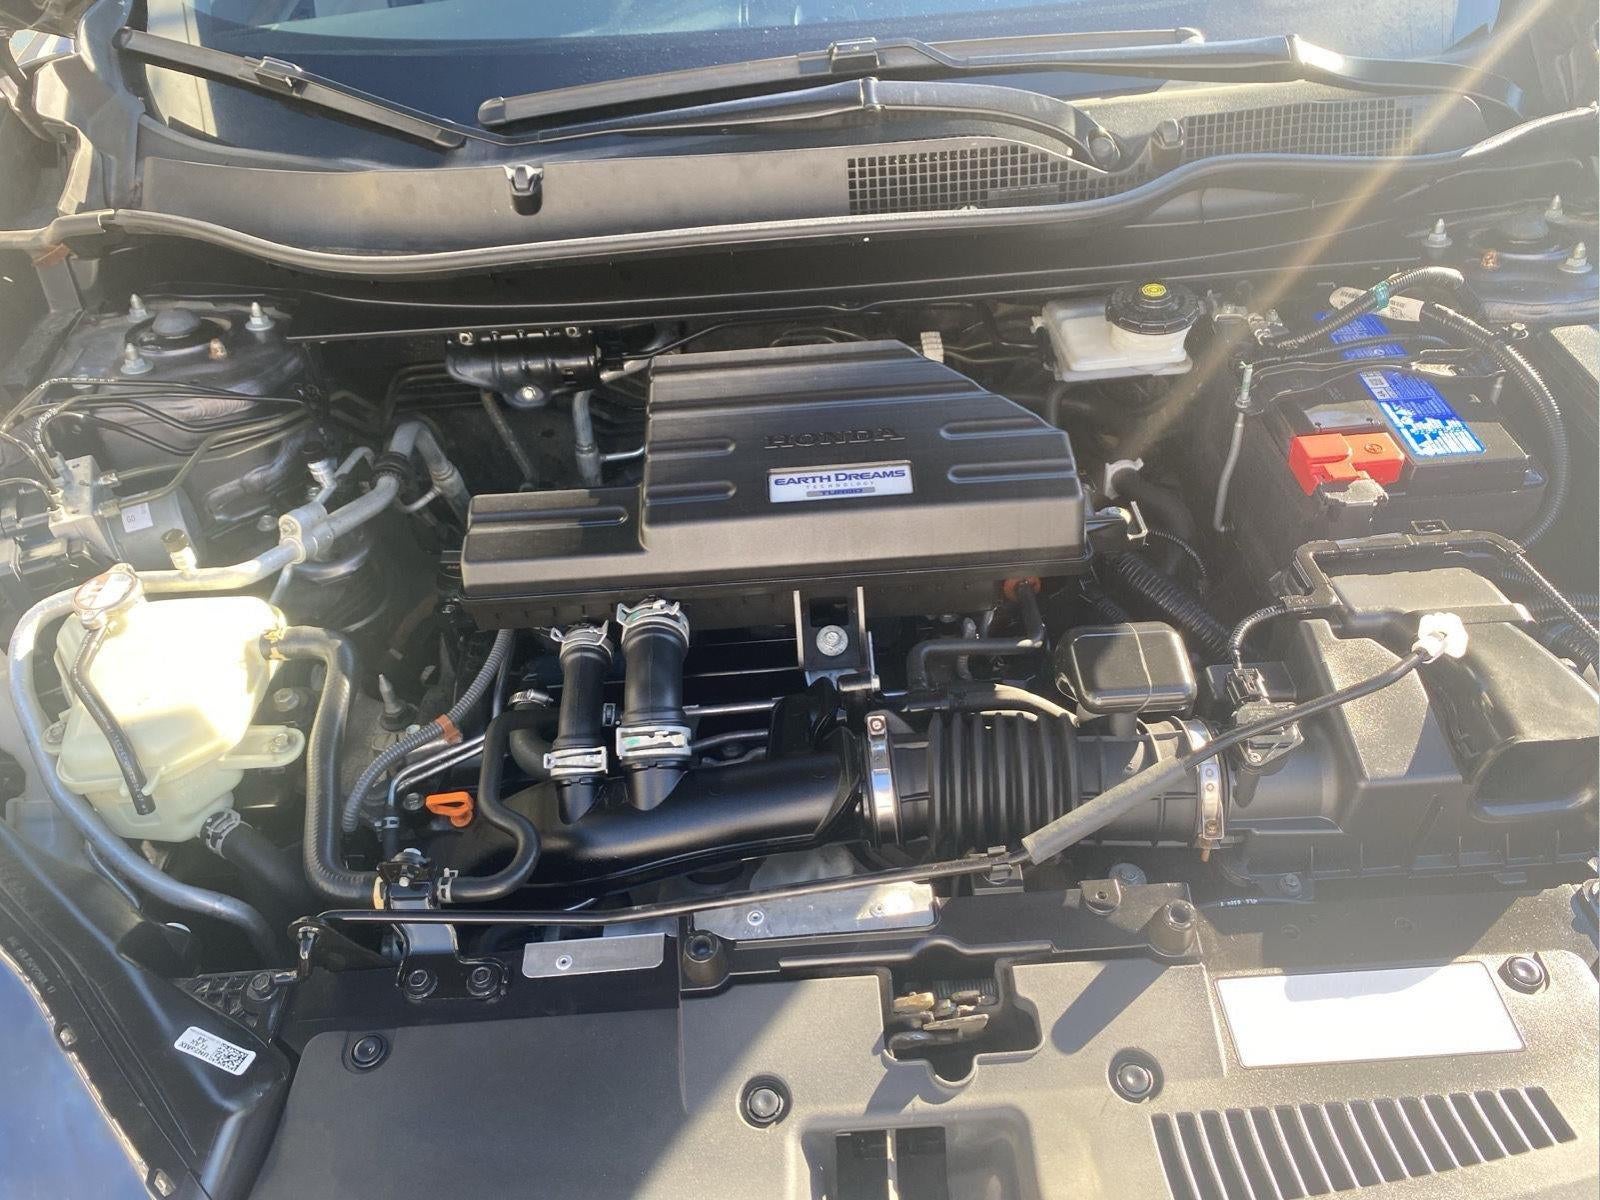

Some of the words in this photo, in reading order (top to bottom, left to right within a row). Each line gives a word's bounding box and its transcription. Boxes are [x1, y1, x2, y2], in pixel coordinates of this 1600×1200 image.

[764, 427, 905, 449] HONDA
[774, 475, 831, 486] EARTH
[834, 469, 906, 482] DREAMS
